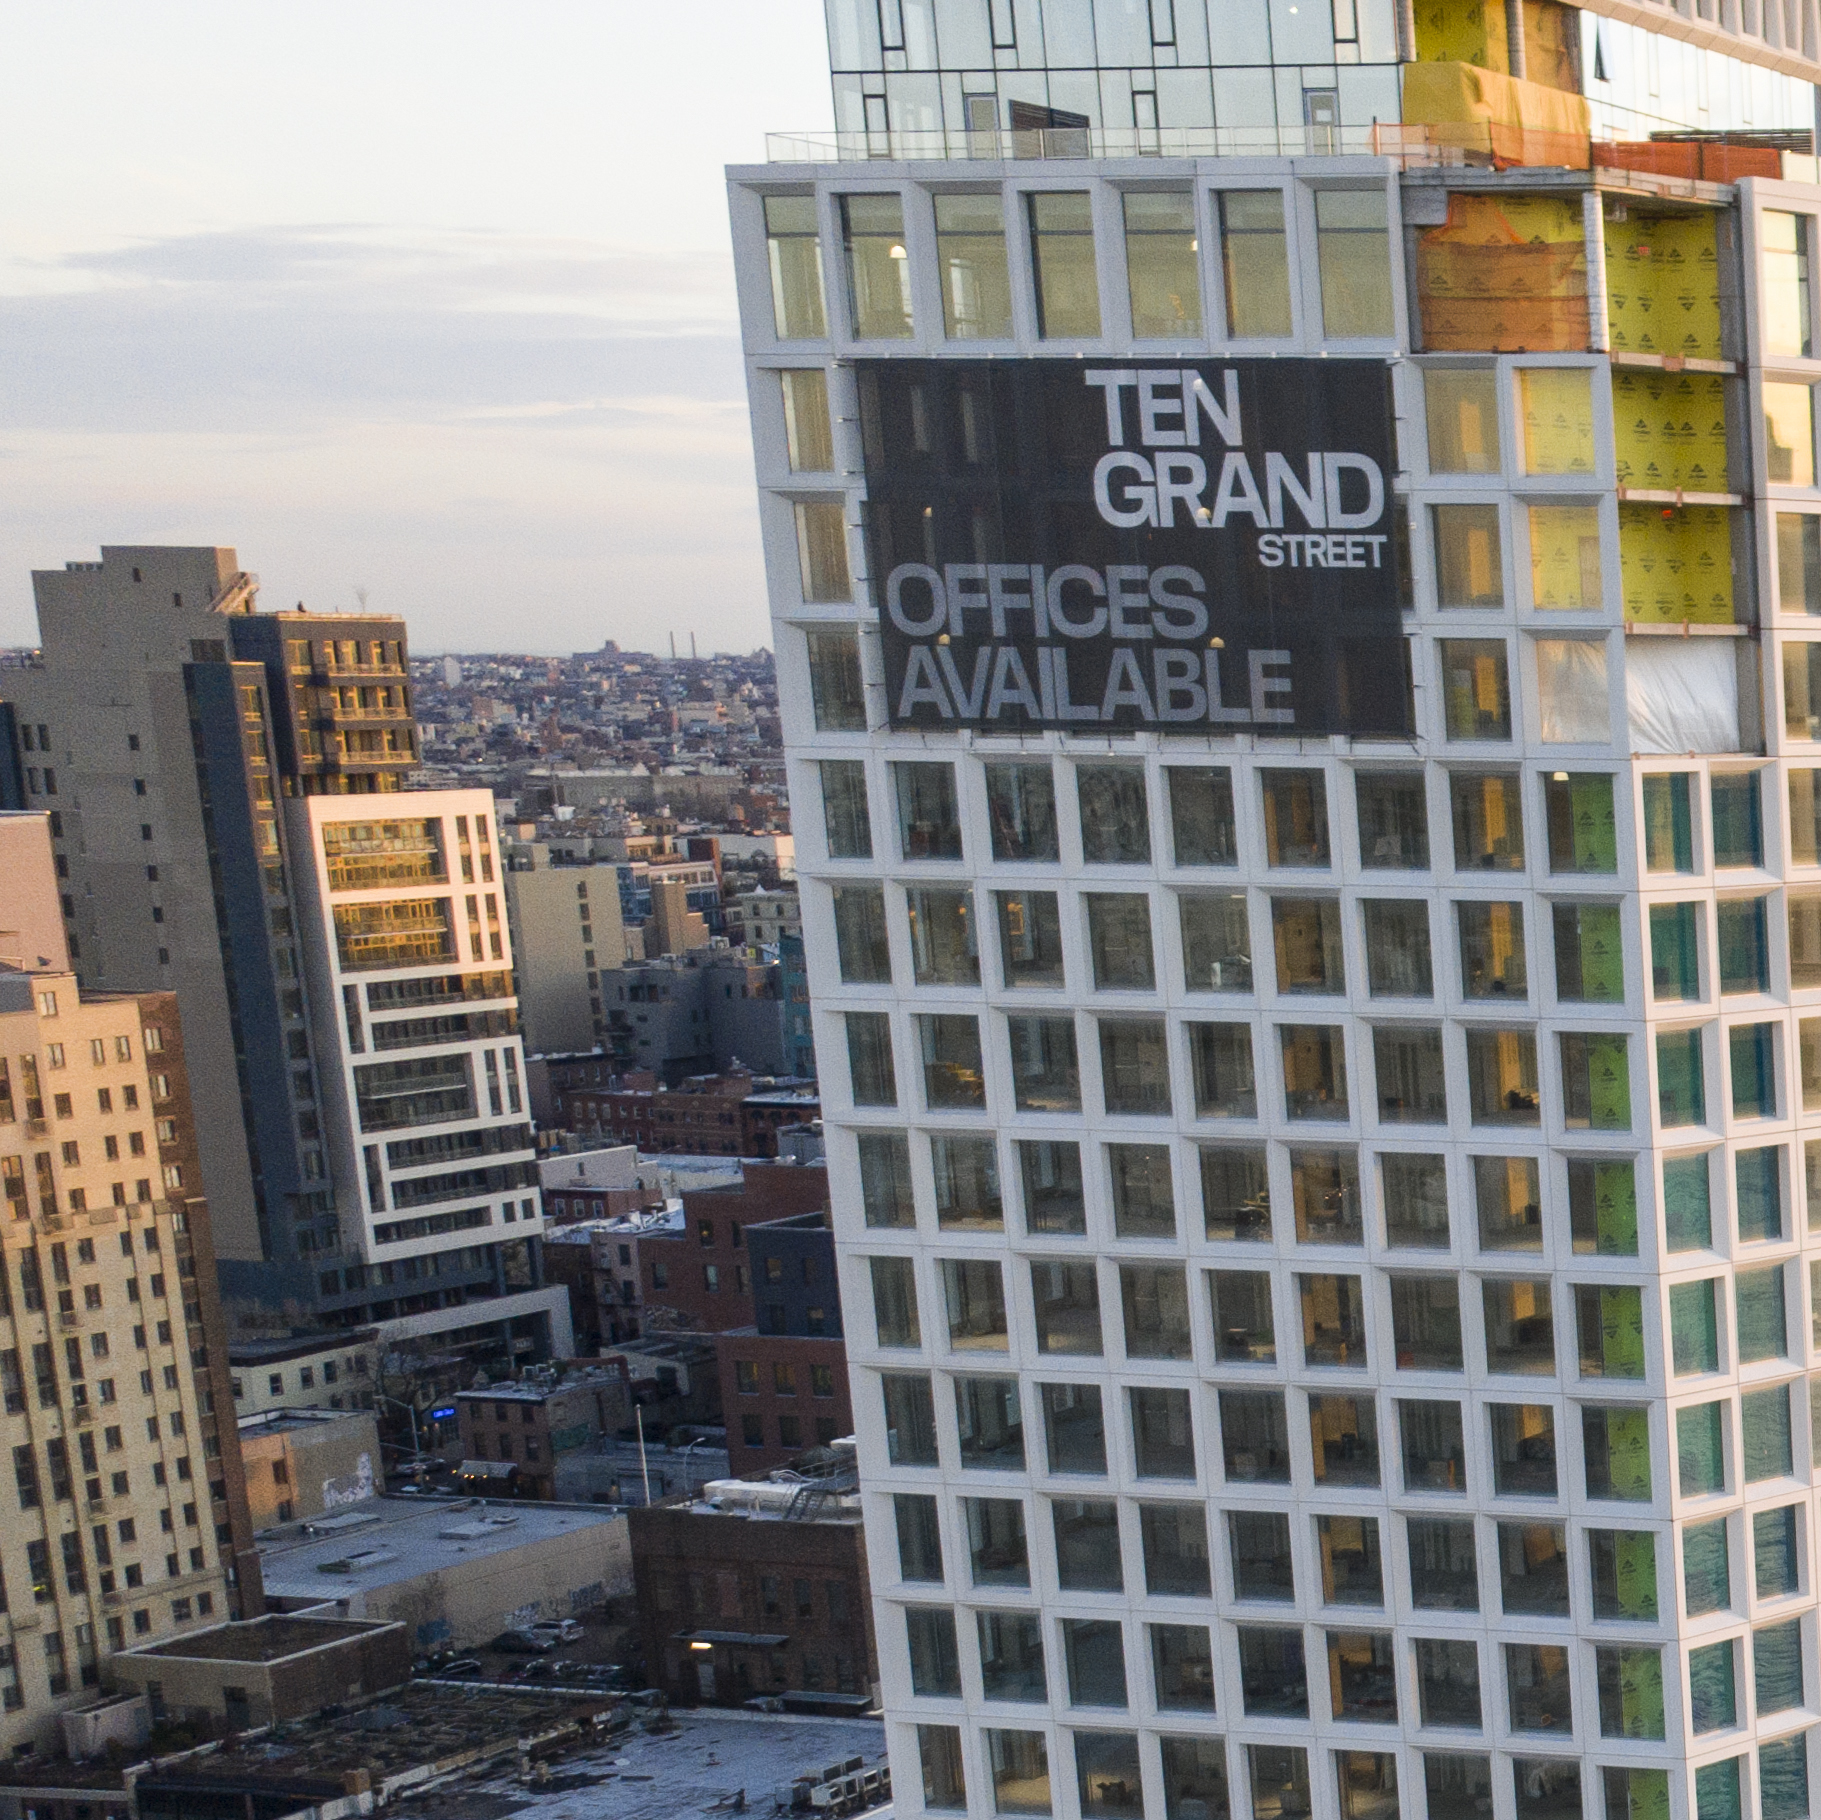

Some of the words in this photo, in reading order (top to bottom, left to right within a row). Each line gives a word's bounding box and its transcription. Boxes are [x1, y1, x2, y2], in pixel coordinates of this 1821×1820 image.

[1085, 369, 1242, 446] TEN
[1093, 451, 1384, 529] GRAND
[1257, 534, 1388, 568] STREET
[886, 562, 1209, 640] OFFICES
[898, 645, 1295, 724] AVAILABLE
